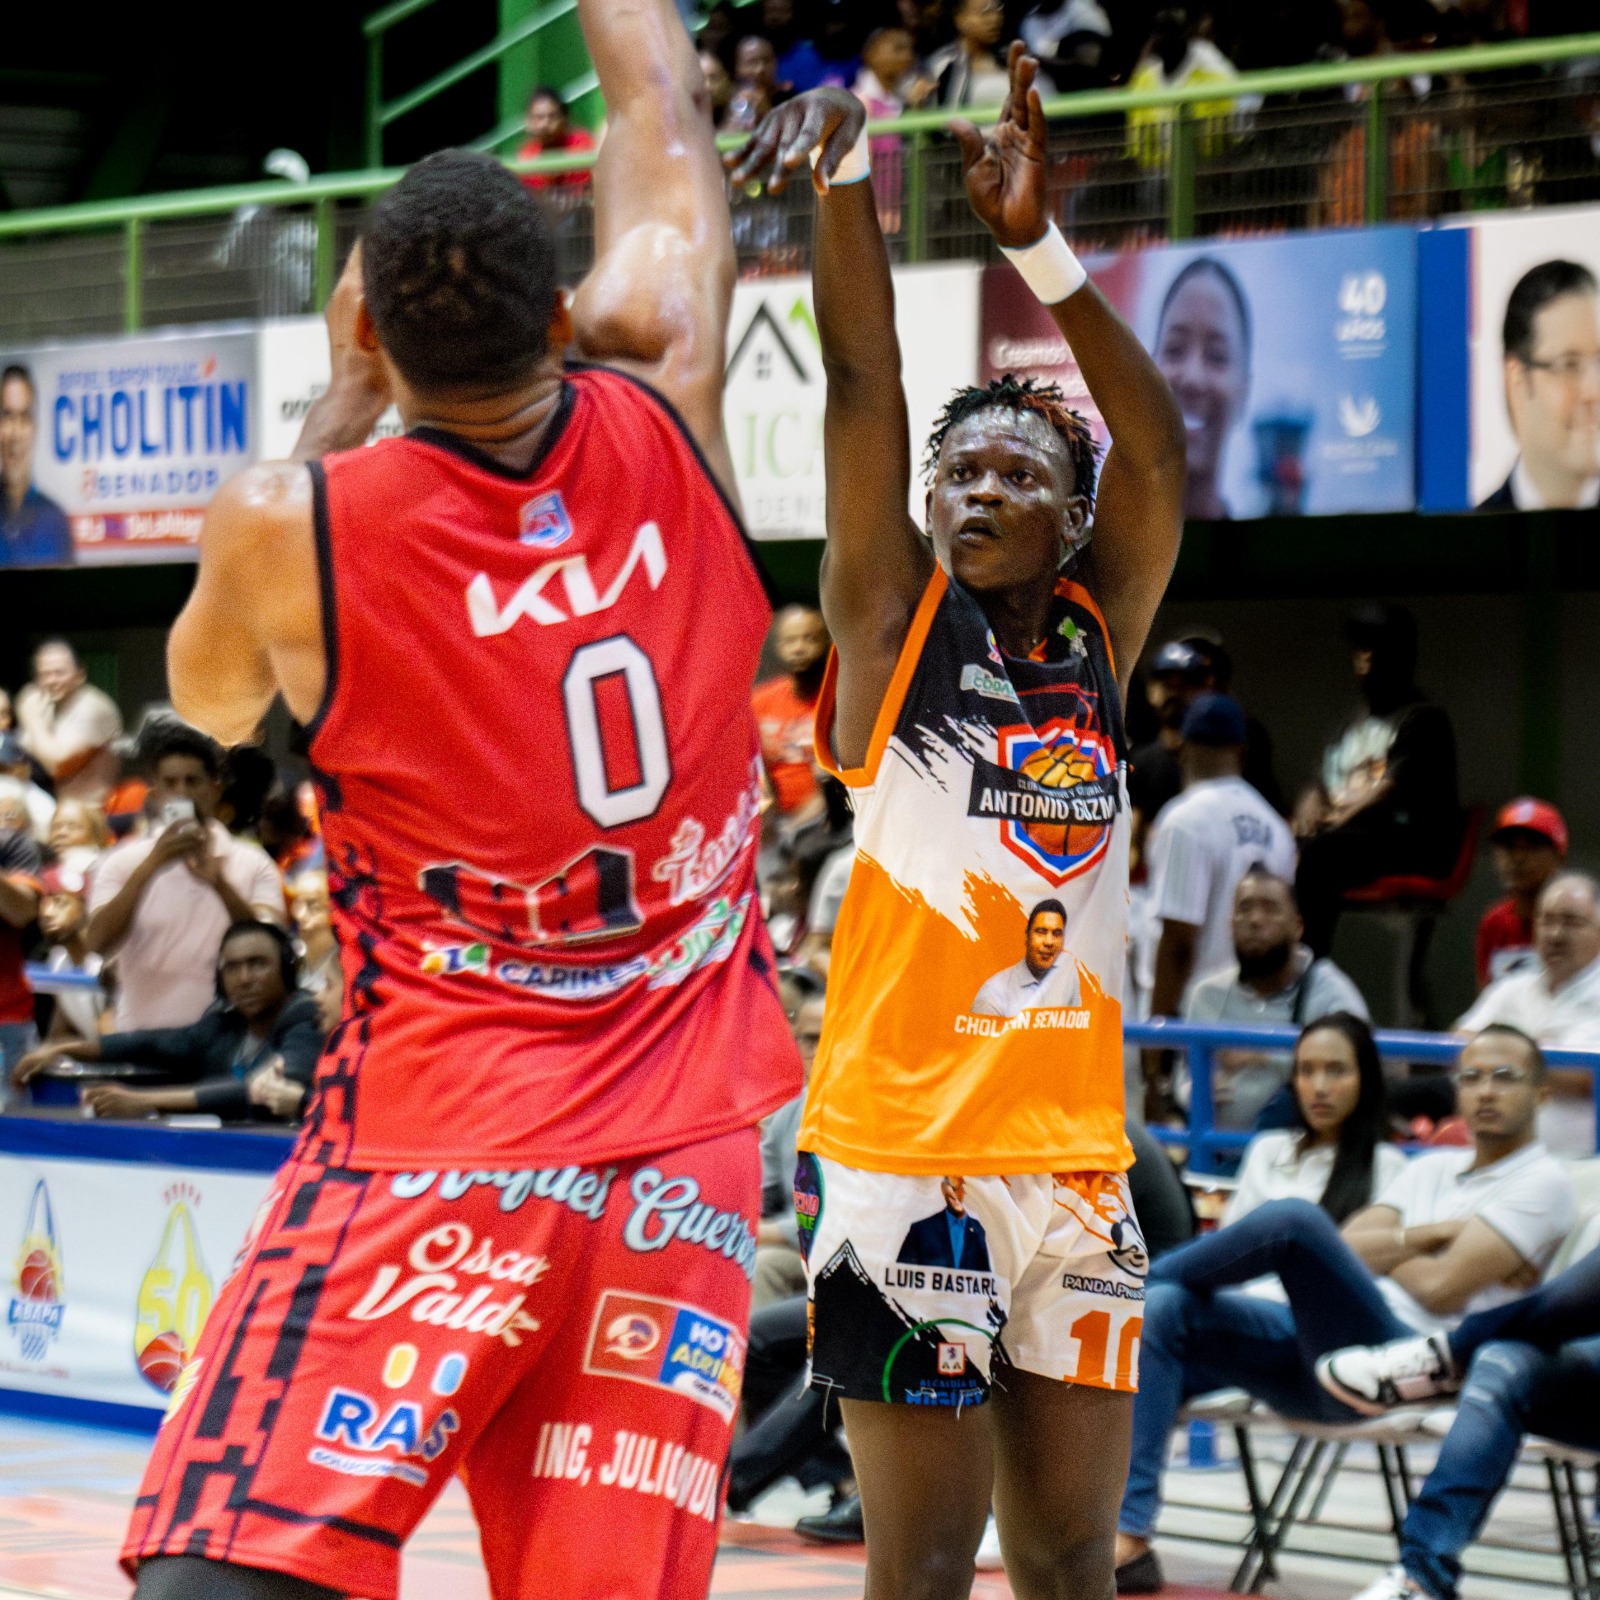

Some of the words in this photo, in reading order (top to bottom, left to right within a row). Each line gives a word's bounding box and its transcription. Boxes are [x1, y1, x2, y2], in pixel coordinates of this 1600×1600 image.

[562, 632, 672, 830] 0
[979, 786, 1069, 820] ANTONIO
[1033, 1009, 1091, 1029] SENADOR
[884, 1266, 926, 1289] LUIS
[1062, 1273, 1114, 1297] PANDA
[318, 1389, 460, 1460] RAS
